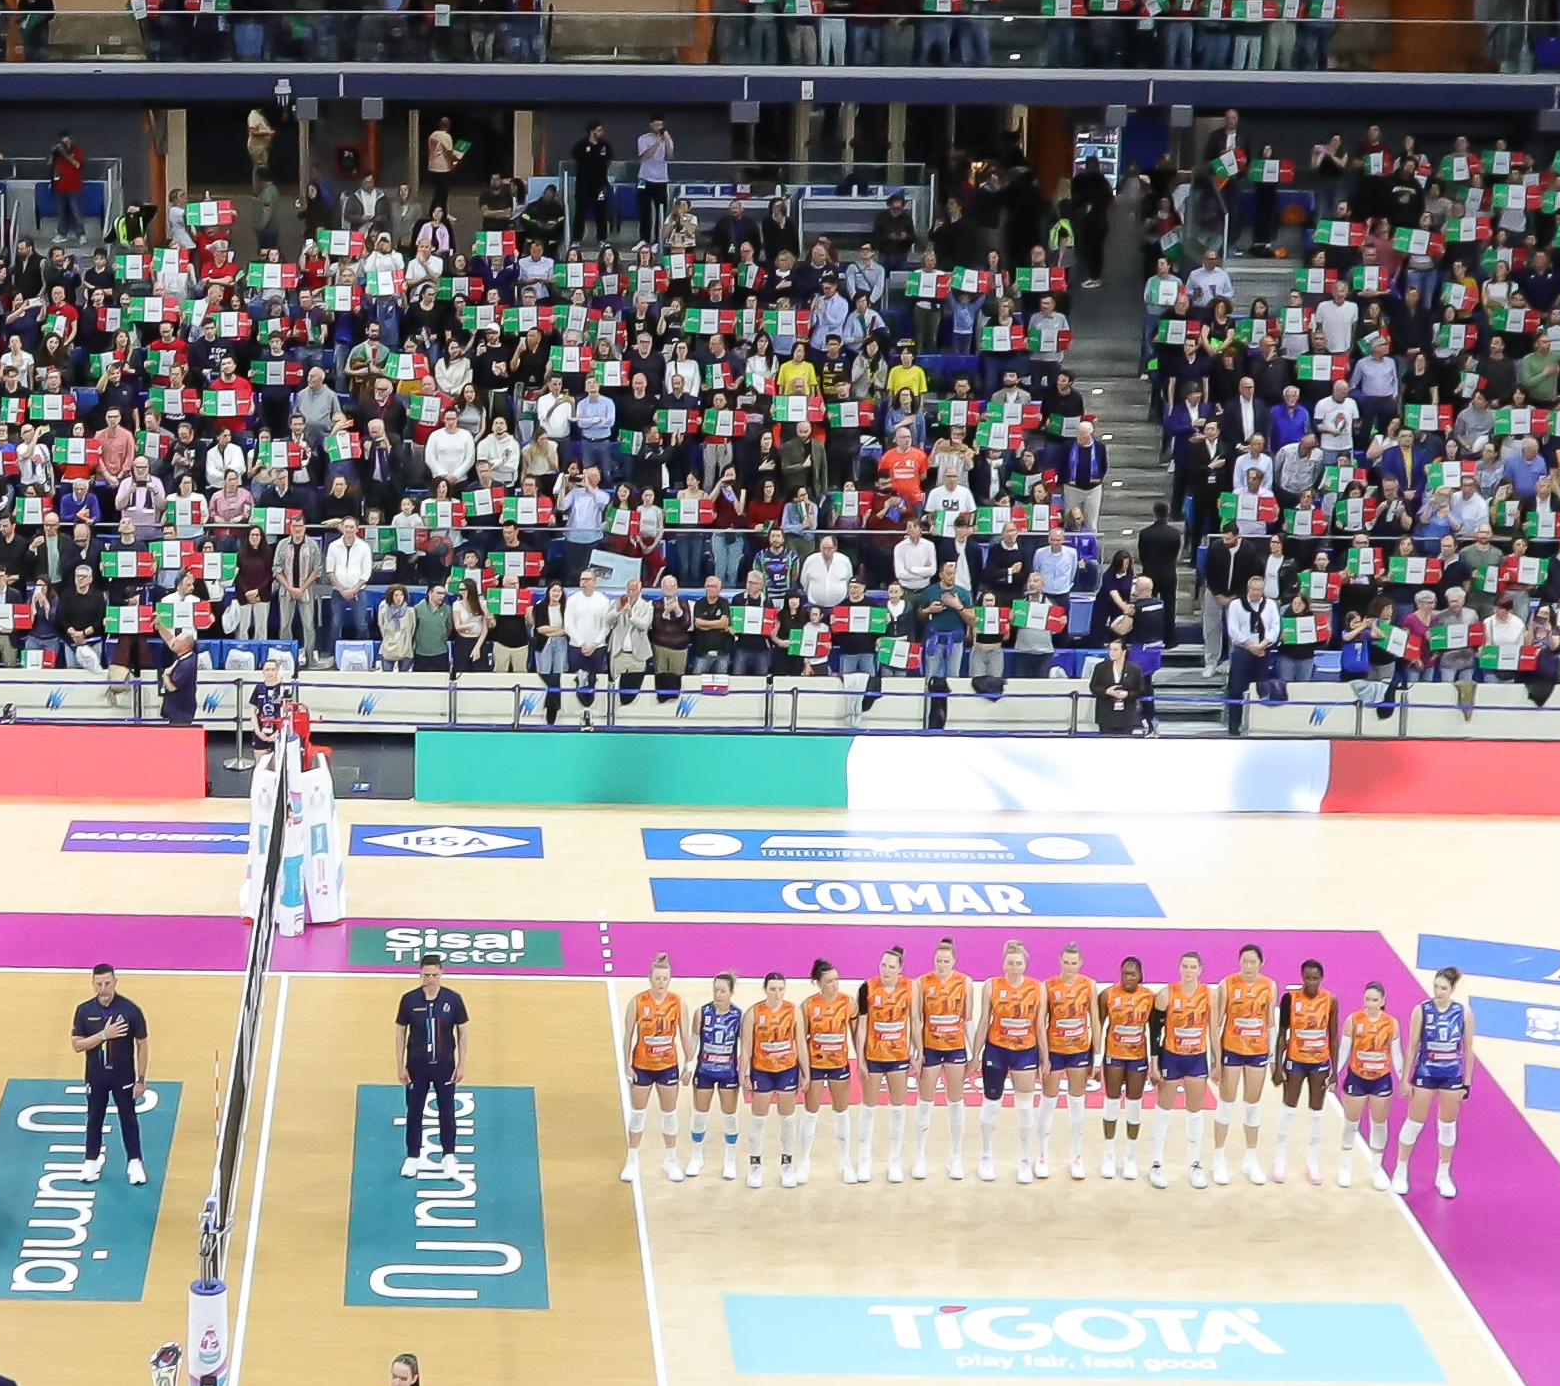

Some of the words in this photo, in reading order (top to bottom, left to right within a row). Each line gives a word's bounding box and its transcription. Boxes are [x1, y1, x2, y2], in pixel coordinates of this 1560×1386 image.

[403, 834, 490, 850] IBSA
[781, 881, 1032, 914] COLMAR
[385, 927, 525, 950] Sisal
[10, 1143, 108, 1293] numia
[956, 1354, 1014, 1371] play
[1082, 1354, 1135, 1371] feel
[1145, 1356, 1218, 1373] good
